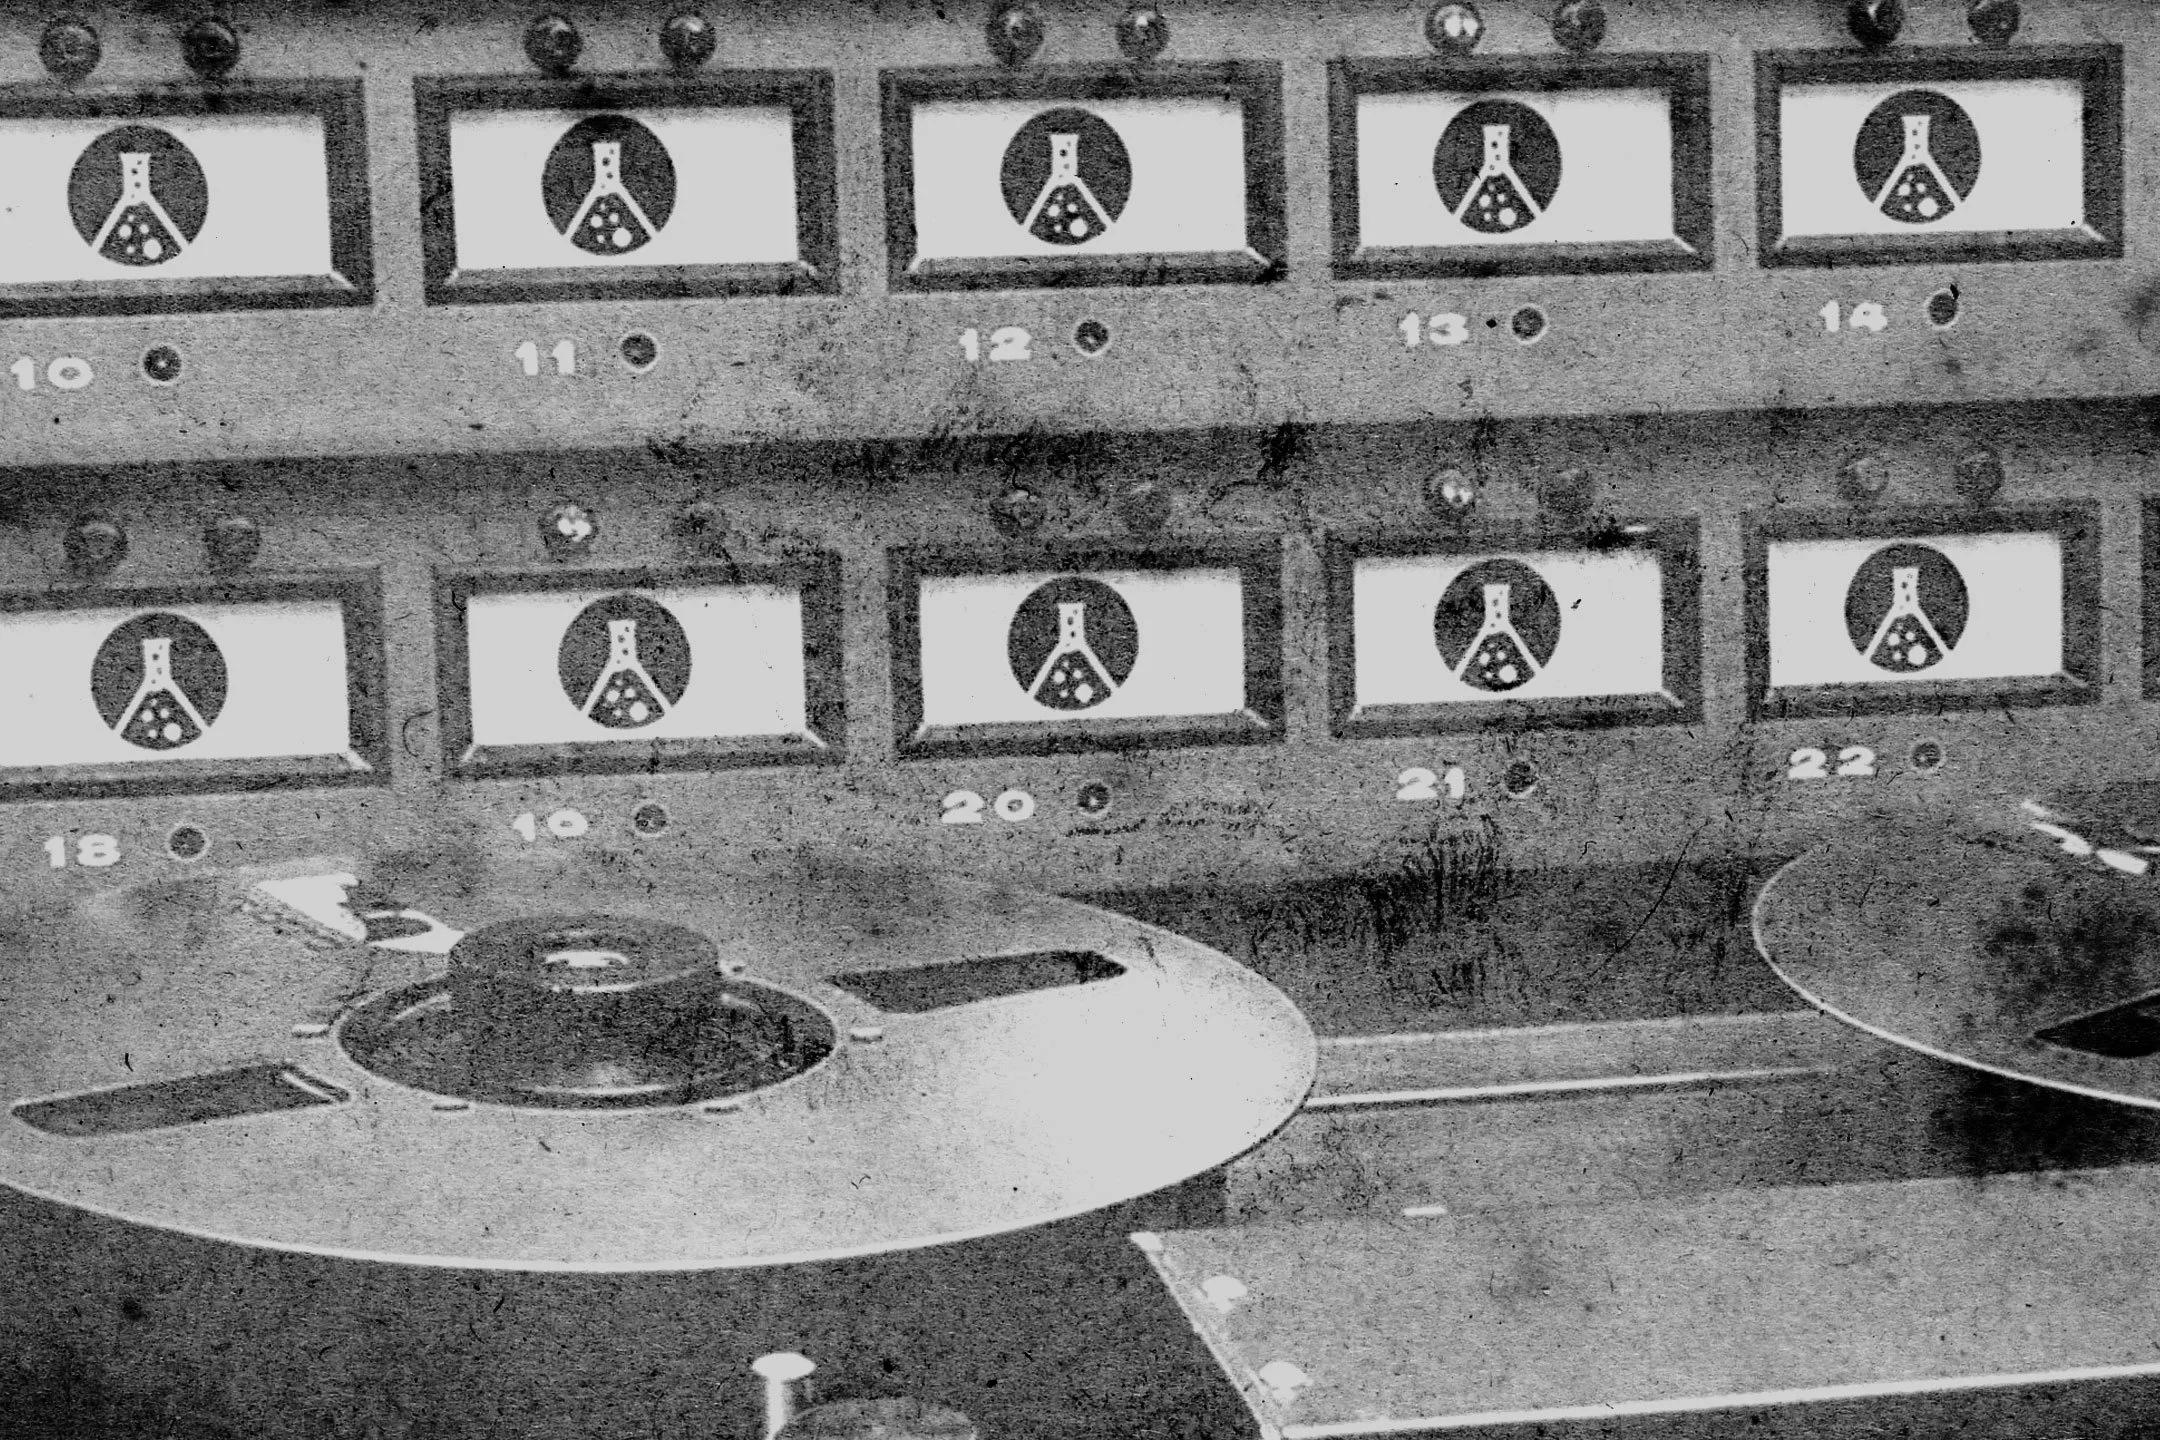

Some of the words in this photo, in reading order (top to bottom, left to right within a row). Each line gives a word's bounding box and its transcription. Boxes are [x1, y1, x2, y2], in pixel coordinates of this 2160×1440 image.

[1400, 312, 1468, 345] 13
[1820, 301, 1887, 332] 14
[515, 340, 575, 374] 11
[959, 327, 1031, 361] 12
[11, 357, 94, 390] 10
[1788, 747, 1875, 778] 22
[1397, 767, 1465, 800] 21
[941, 790, 1035, 823] 20
[45, 834, 121, 867] 18
